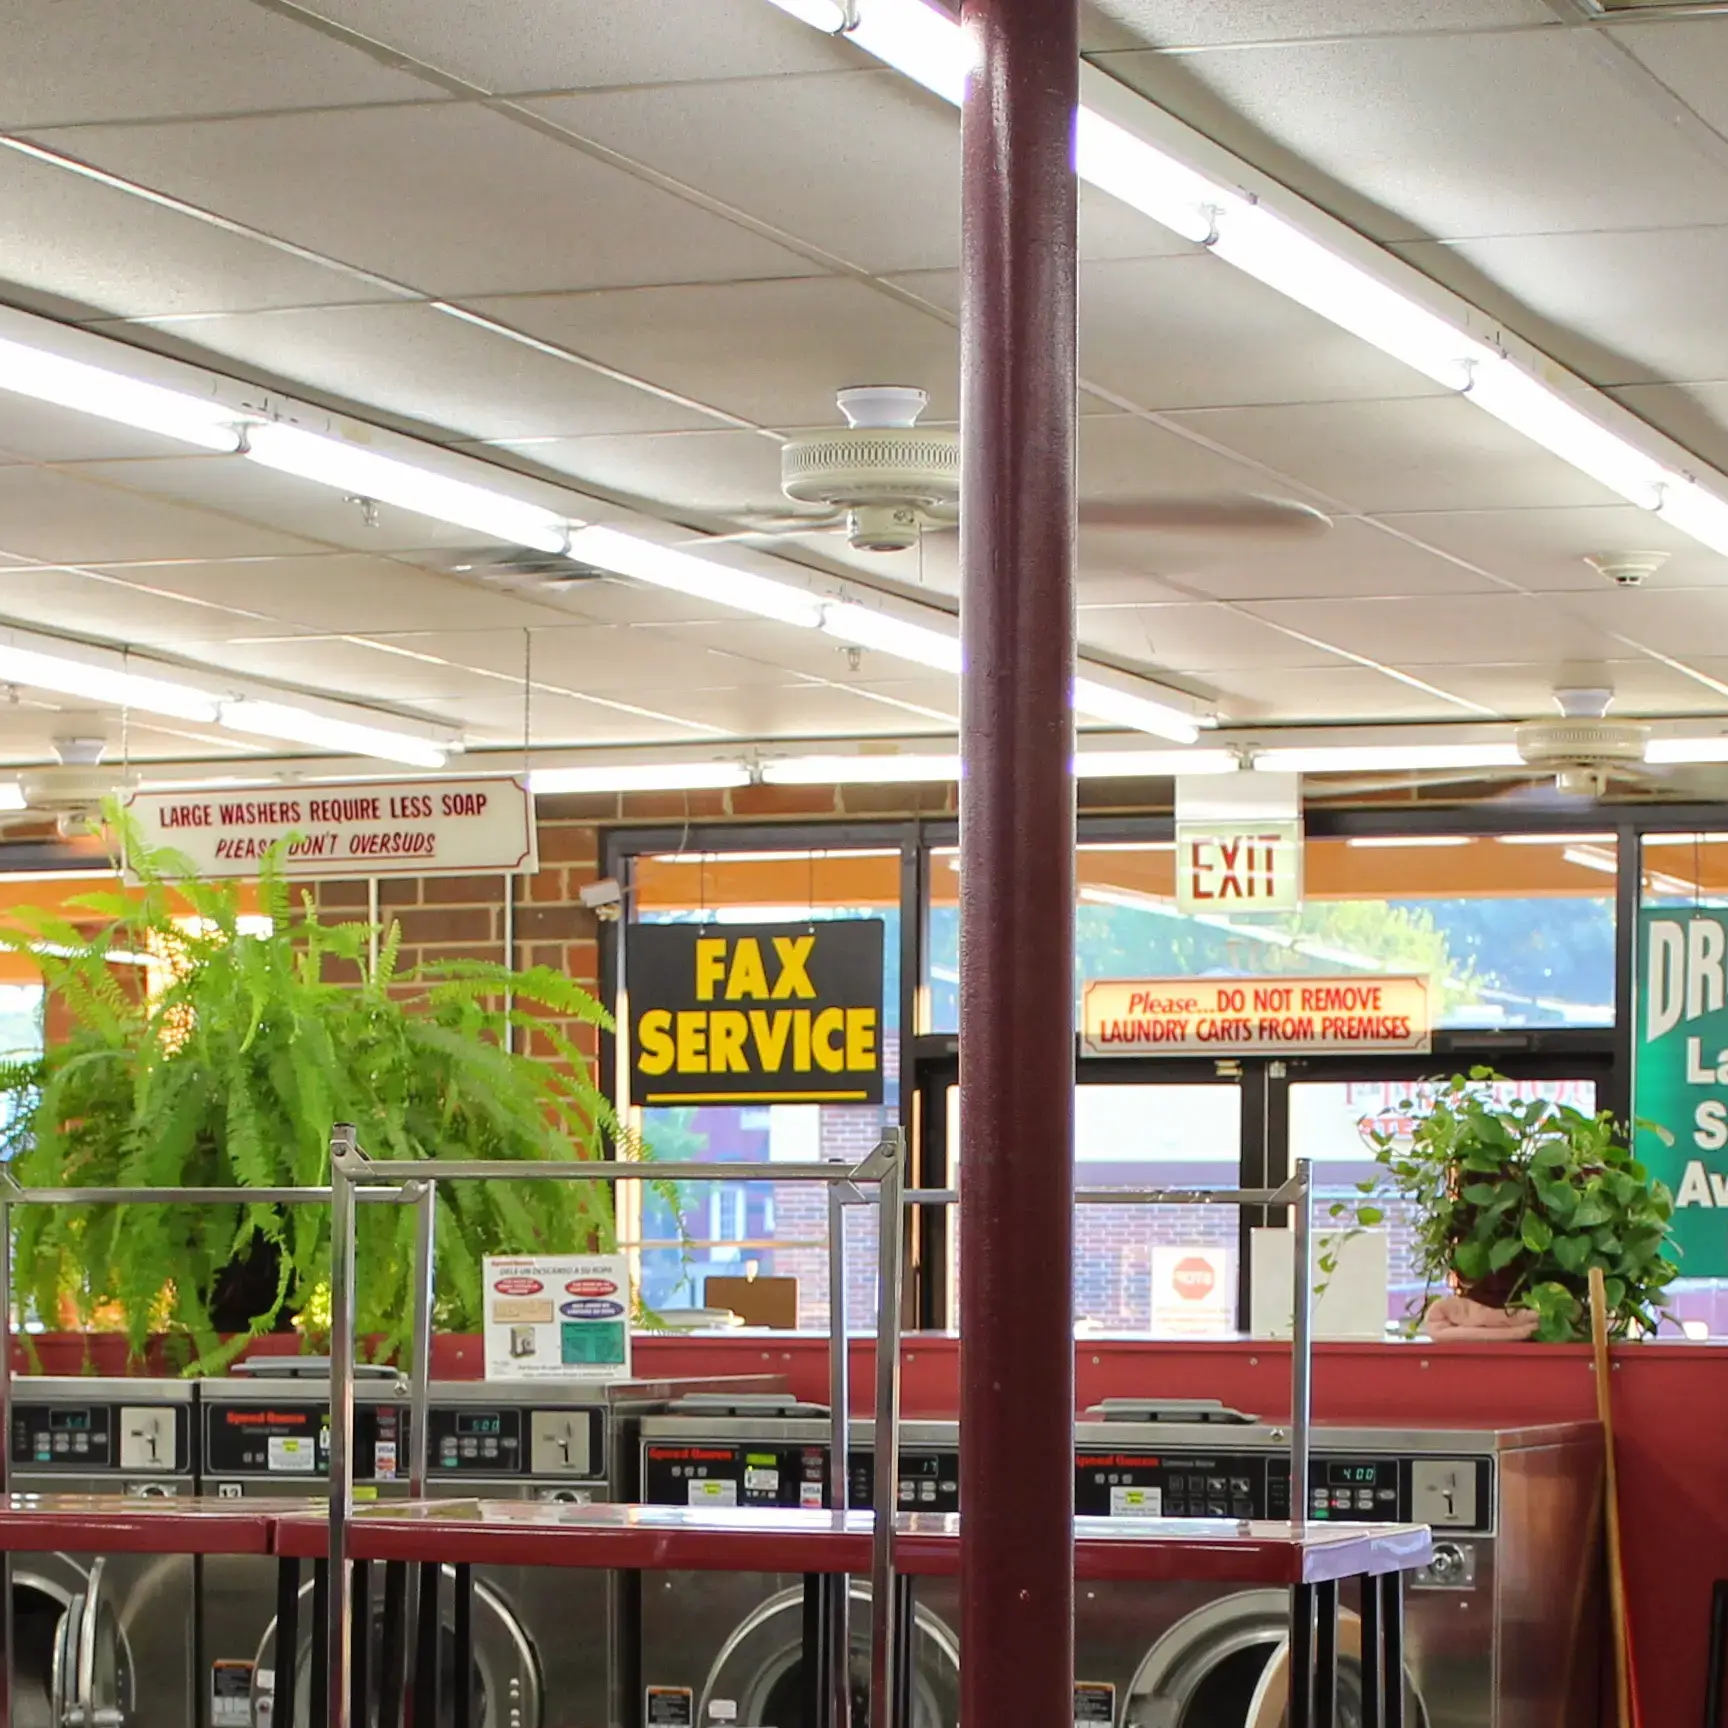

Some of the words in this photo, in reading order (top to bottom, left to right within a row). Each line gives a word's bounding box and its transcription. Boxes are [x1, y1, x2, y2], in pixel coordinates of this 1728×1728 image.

[160, 803, 212, 828] LARGE
[220, 798, 301, 825] WASHERS
[310, 796, 381, 823] REQUIRE
[390, 795, 433, 819] LESS
[442, 793, 488, 817] SOAP
[215, 837, 276, 859] PLEAS
[288, 832, 338, 856] DON'T
[349, 833, 436, 856] OVERSUDS
[1191, 834, 1282, 900] EXIT
[695, 936, 818, 1000] FAX
[1253, 988, 1294, 1013] NOT
[1301, 986, 1382, 1012] REMOVE
[637, 1006, 877, 1076] SERVICE
[1099, 1018, 1189, 1044] LAUNDRY
[1195, 1017, 1252, 1042] CARTS
[1258, 1017, 1315, 1042] FROM
[1321, 1015, 1411, 1041] PREMISES
